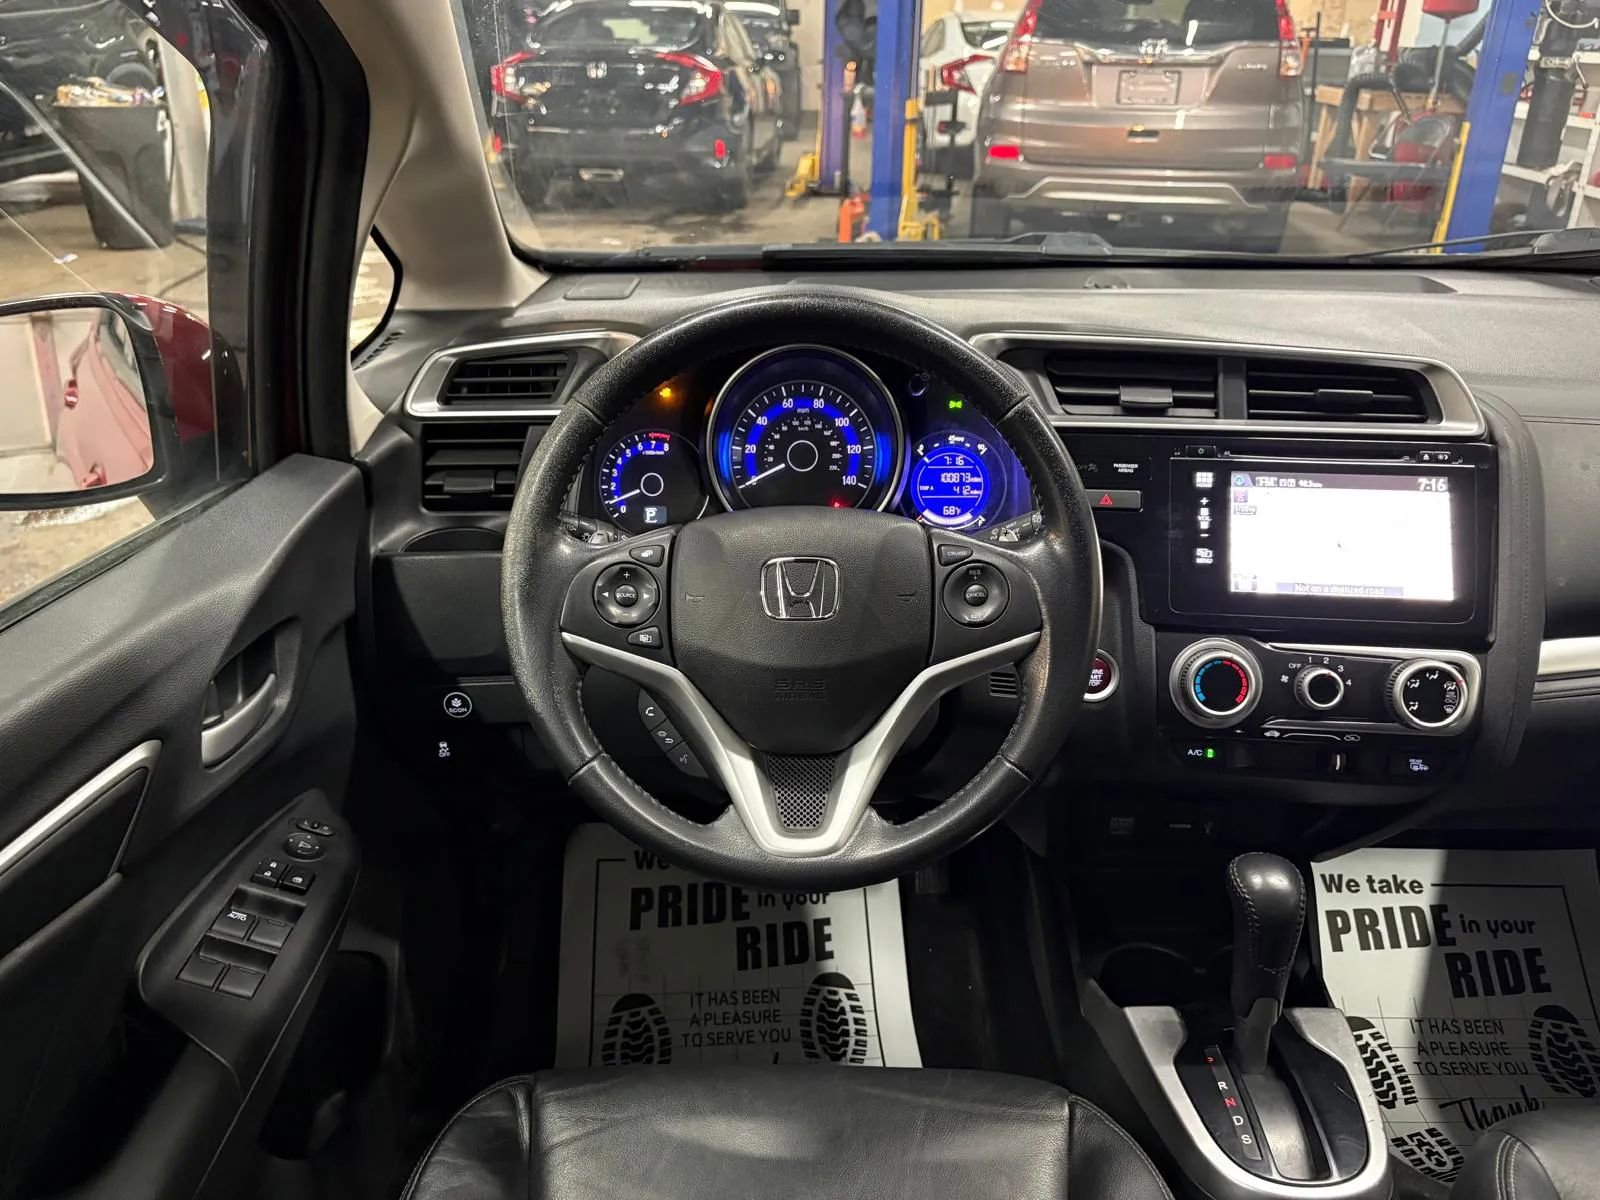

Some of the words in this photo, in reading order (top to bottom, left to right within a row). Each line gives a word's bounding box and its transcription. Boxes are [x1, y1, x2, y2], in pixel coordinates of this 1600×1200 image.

[782, 399, 794, 409] 60
[813, 399, 825, 409] 80
[756, 416, 768, 426] 40
[834, 417, 850, 427] 100
[637, 442, 644, 451] 6
[650, 440, 656, 449] 7
[663, 443, 670, 451] 8
[744, 444, 757, 454] 20
[846, 444, 862, 454] 120
[625, 448, 632, 457] 5
[616, 457, 622, 465] 4
[612, 468, 618, 477] 3
[842, 475, 857, 486] 140
[1417, 477, 1447, 492] 7:16
[610, 482, 616, 490] 2
[620, 505, 627, 514] 0
[1337, 665, 1344, 673] 3
[1320, 873, 1361, 894] We
[1366, 874, 1425, 895] take
[629, 881, 751, 931] PRIDE
[227, 911, 248, 921] AUTO
[1325, 904, 1457, 953] PRIDE
[1459, 913, 1482, 935] in
[1486, 917, 1537, 939] your
[736, 917, 835, 972] RIDE
[1444, 947, 1553, 999] RIDE
[690, 992, 704, 1009] IT
[708, 991, 738, 1006] HAS
[742, 988, 780, 1005] BEEN
[689, 1012, 701, 1027] A
[703, 1009, 782, 1027] PLEASURE
[1410, 1019, 1425, 1035] IT
[1428, 1020, 1461, 1035] HAS
[1464, 1020, 1504, 1035] BEEN
[681, 1032, 703, 1048] TO
[706, 1029, 755, 1047] SERVE
[759, 1027, 792, 1044] YOU
[1417, 1041, 1430, 1056] A
[1430, 1041, 1512, 1057] PLEASURE
[1413, 1061, 1439, 1076] TO
[1440, 1061, 1492, 1076] SERVE
[1493, 1061, 1529, 1076] YOU
[1217, 1081, 1229, 1091] R
[1225, 1097, 1237, 1108] N
[1232, 1115, 1244, 1126] D
[1241, 1134, 1253, 1145] S
